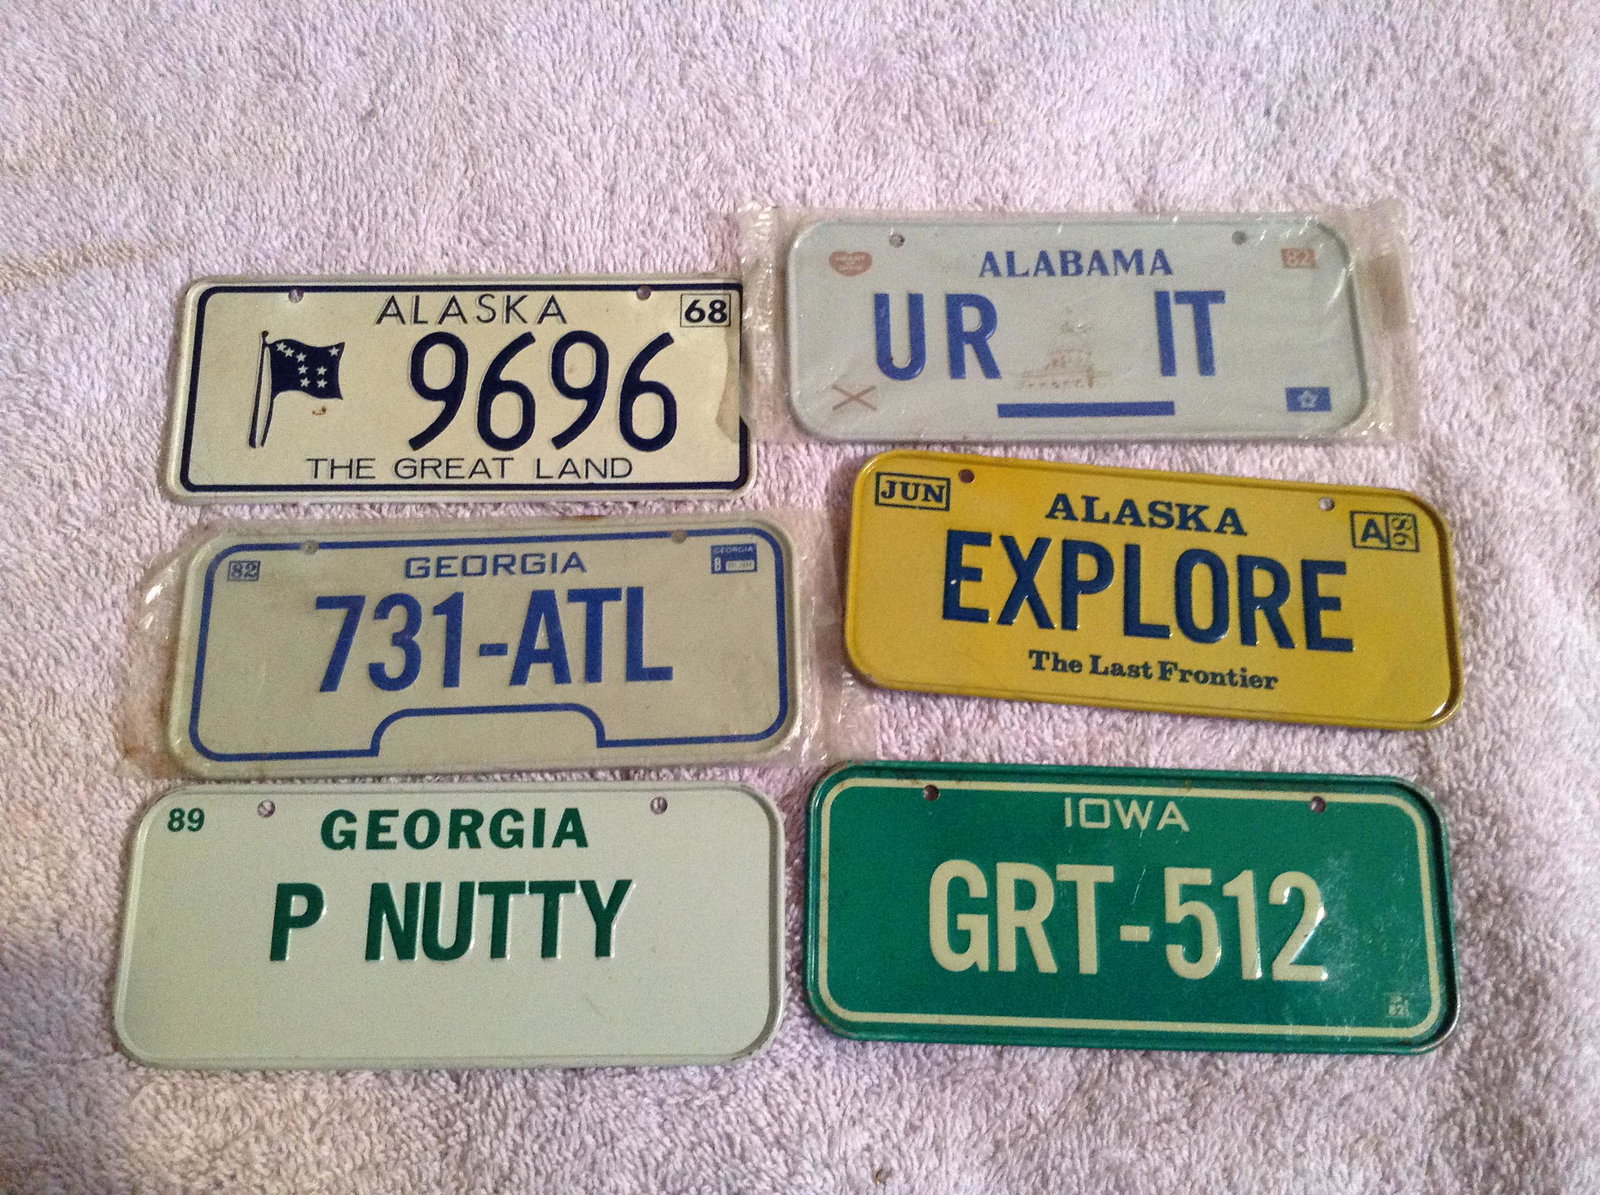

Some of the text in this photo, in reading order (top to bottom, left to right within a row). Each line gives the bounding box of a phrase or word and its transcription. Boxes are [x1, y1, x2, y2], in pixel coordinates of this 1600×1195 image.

[978, 248, 1174, 278] ALABAMA
[375, 293, 567, 325] ALASKA
[685, 299, 727, 323] 68
[873, 290, 1226, 380] UR IT
[409, 331, 677, 451] 9696
[306, 456, 633, 480] THE GREAT LAND
[881, 480, 945, 503] JUN
[1045, 493, 1248, 537] ALASKA
[405, 552, 588, 580] GEORGIA
[942, 530, 1355, 653] EXPLORE
[315, 587, 673, 693] 731-ATL
[1029, 649, 1278, 690] The Last Frontier
[167, 808, 204, 832] 89
[320, 807, 589, 850] GEORGIA
[1065, 797, 1190, 832] IOWA
[270, 879, 635, 961] P NUTTY
[929, 858, 1328, 981] GRT-512
